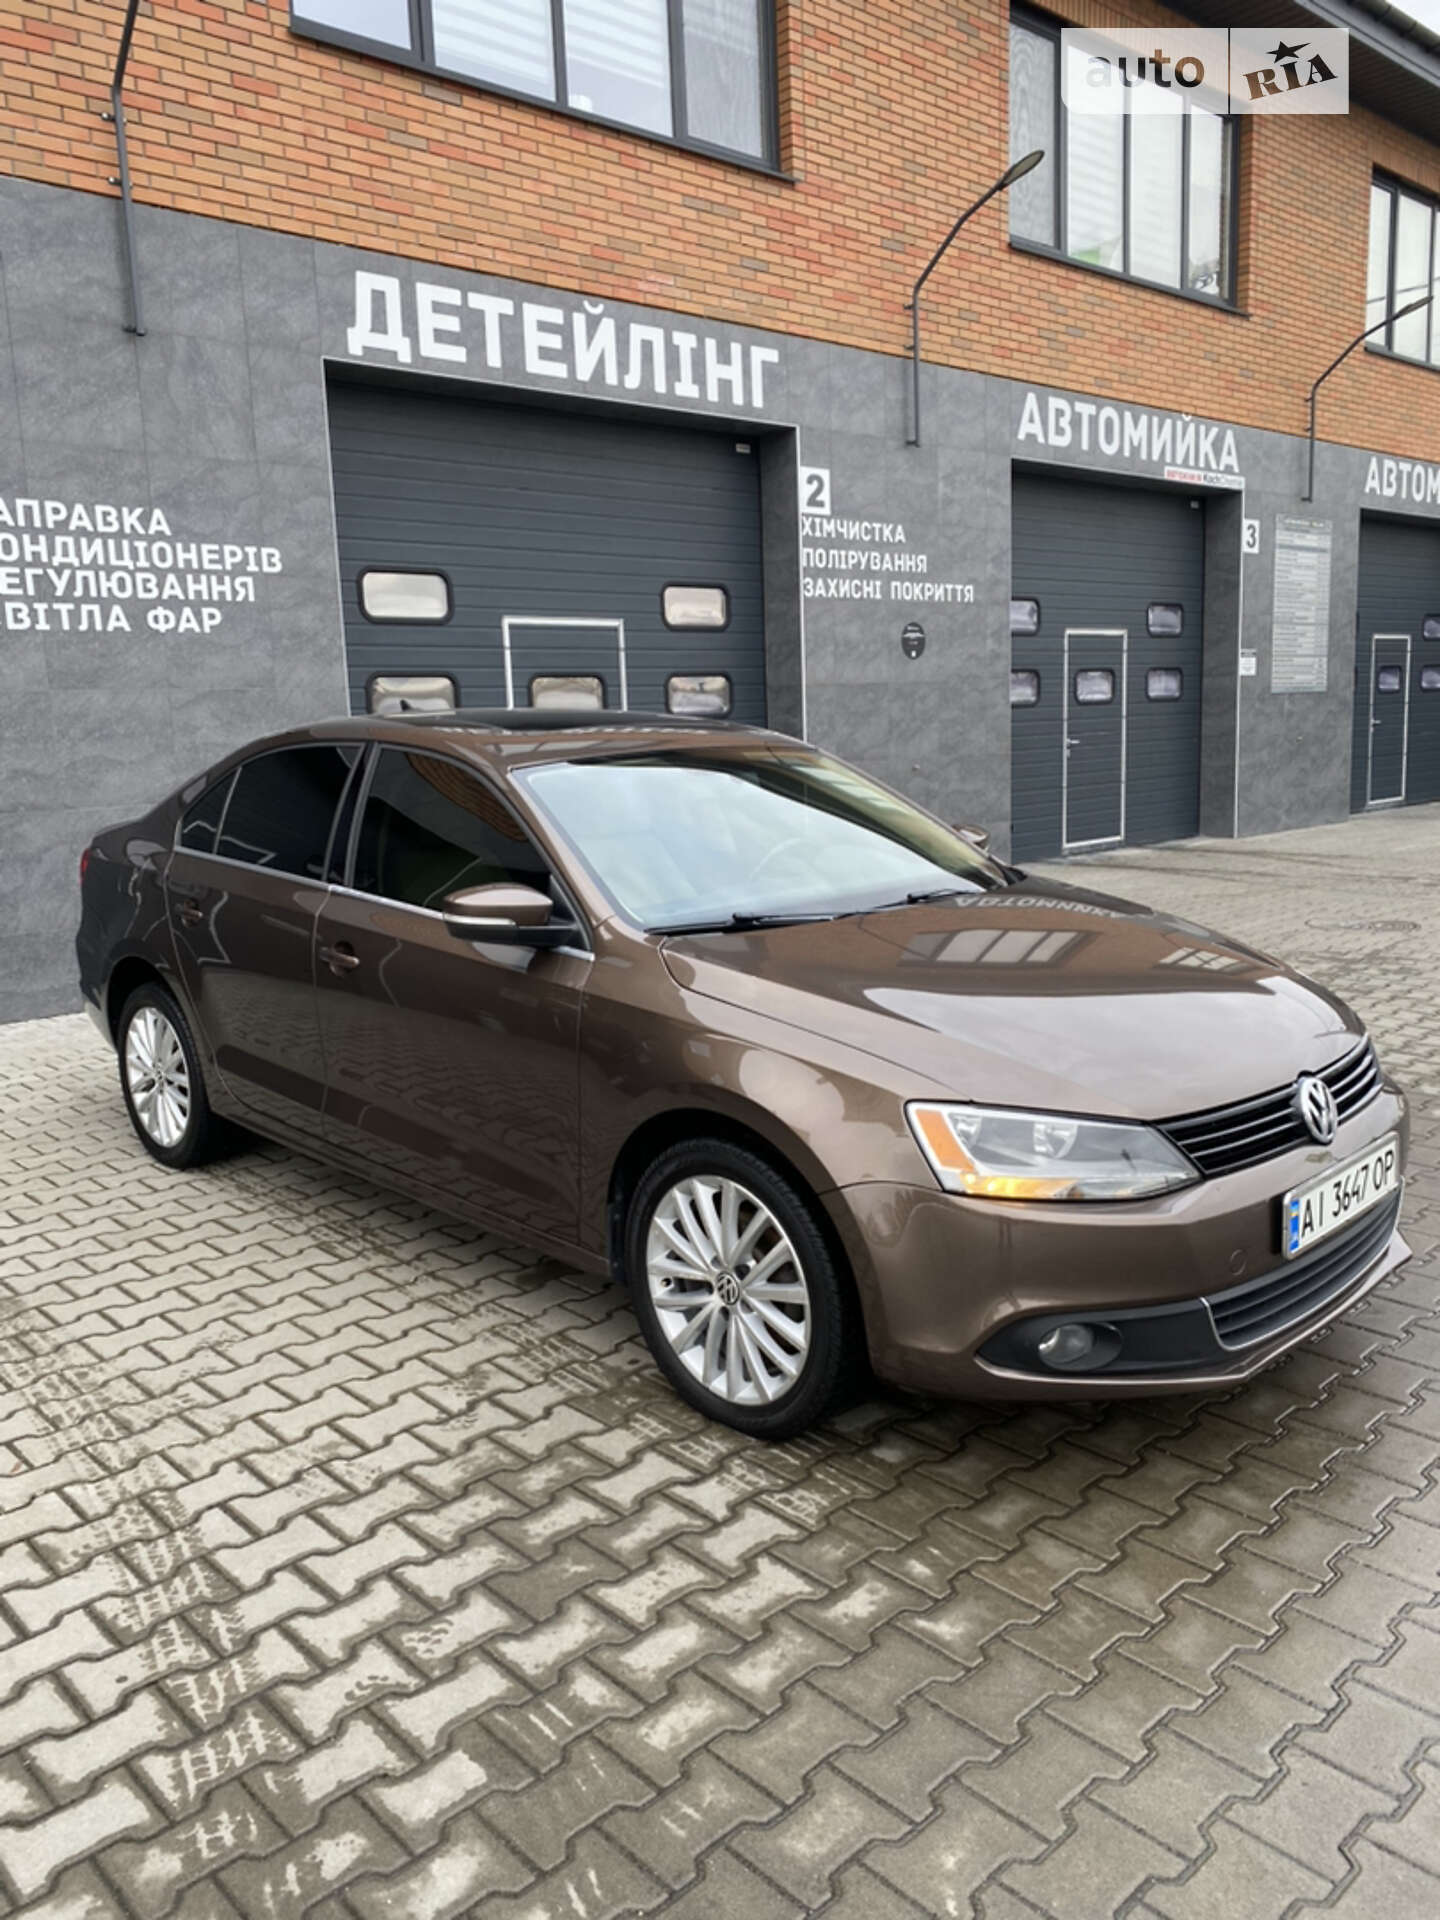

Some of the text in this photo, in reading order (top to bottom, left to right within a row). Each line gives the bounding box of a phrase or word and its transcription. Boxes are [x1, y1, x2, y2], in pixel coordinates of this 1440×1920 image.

[347, 270, 779, 408] ДЕТЕЙЛІНГ
[1017, 392, 1240, 473] АВТОМИЙКА
[806, 474, 825, 508] 2
[802, 516, 906, 543] ХІМЧИСТКА
[1247, 524, 1257, 548] 3
[802, 547, 928, 573] ПОЛІРУВАННЯ
[803, 578, 974, 603] ЗАХИСНІ ПОКРИТТЯ
[0, 601, 222, 633] ВІТЛА ФАР
[1301, 1149, 1394, 1239] AI 3647 OP
